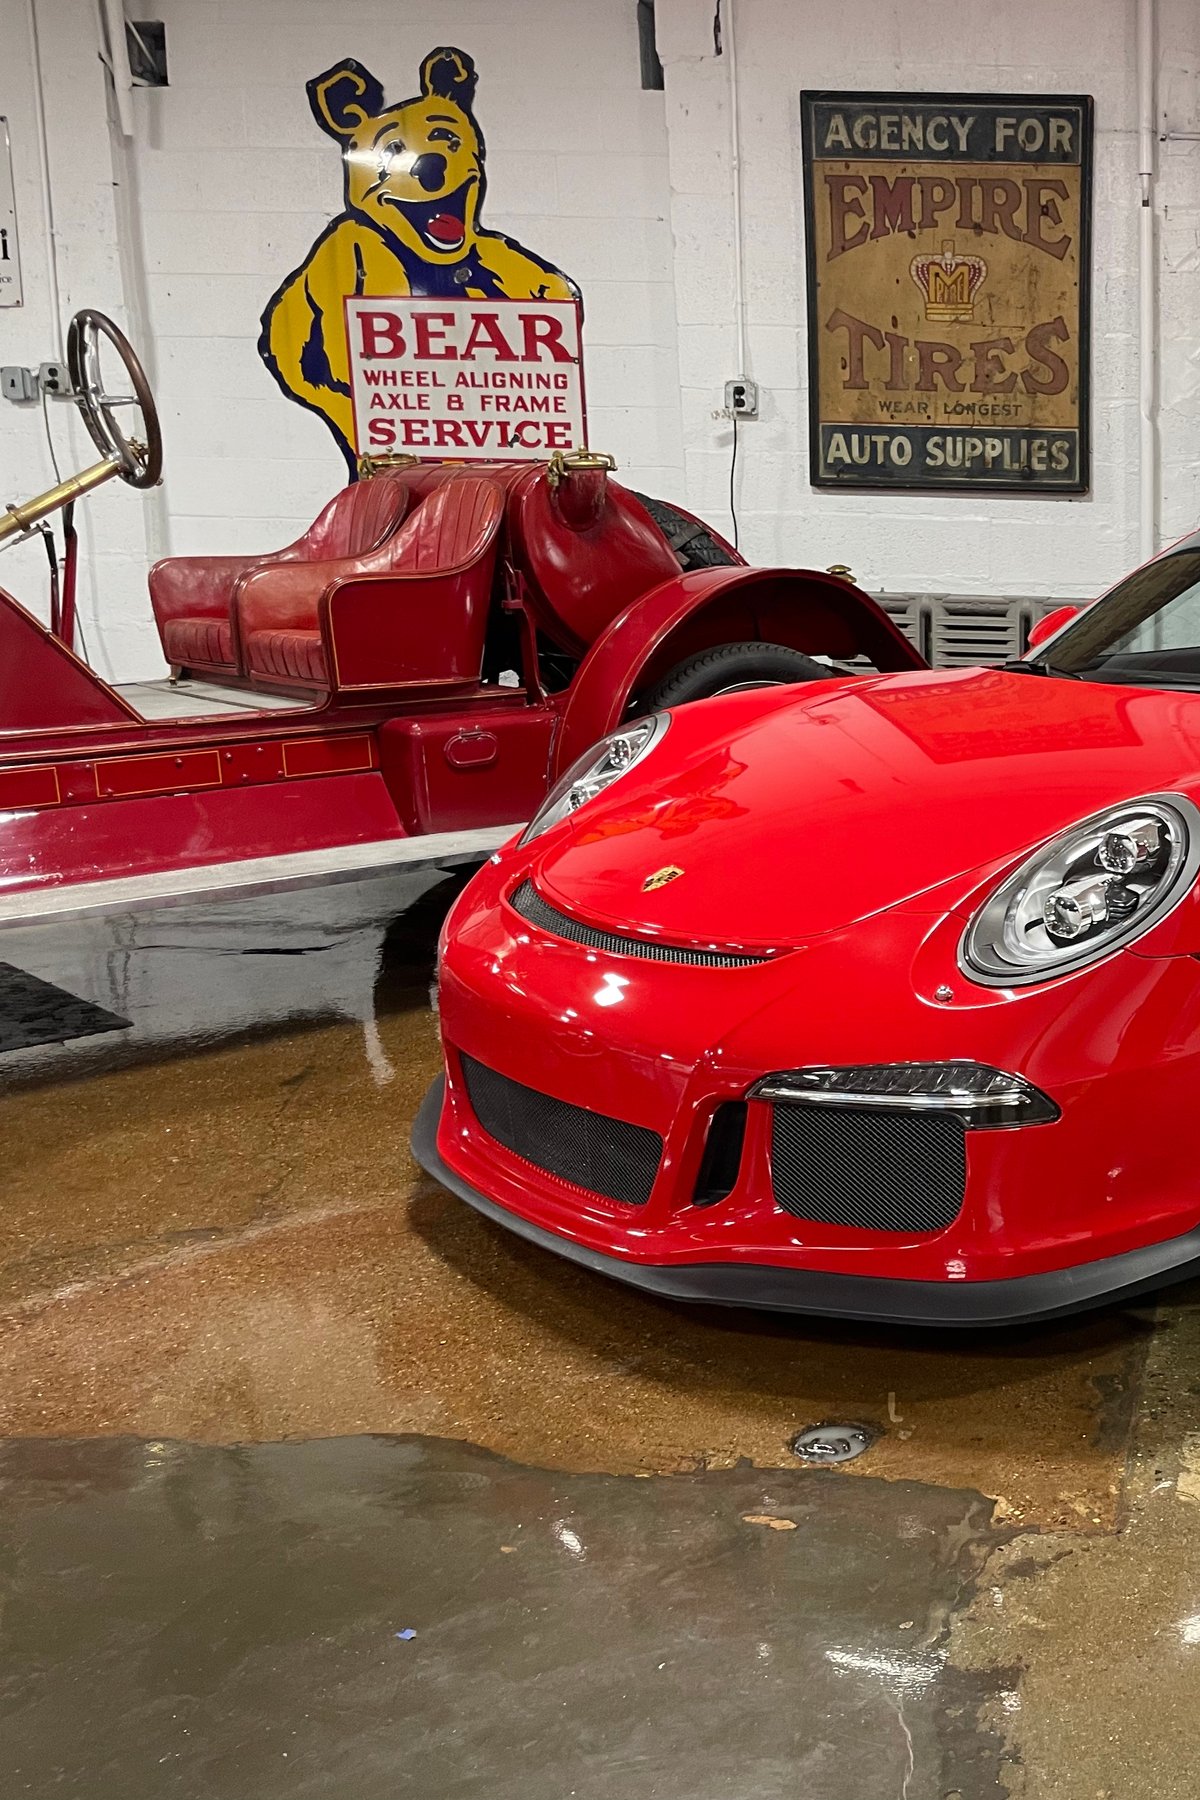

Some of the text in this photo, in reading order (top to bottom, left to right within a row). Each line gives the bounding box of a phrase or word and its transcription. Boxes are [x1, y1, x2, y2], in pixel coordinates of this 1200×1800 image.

[824, 113, 1073, 154] AGENCY FOR
[824, 174, 1072, 262] EMPIRE
[356, 311, 574, 363] BEAR
[825, 307, 1071, 396] TIRES
[363, 369, 569, 390] WHEEL ALIGNING
[370, 393, 567, 413] AXLE & FRAME
[879, 400, 1023, 417] WEAR LONGEST
[368, 418, 573, 449] SERVICE
[827, 433, 1070, 471] AUTO SUPPLIES
